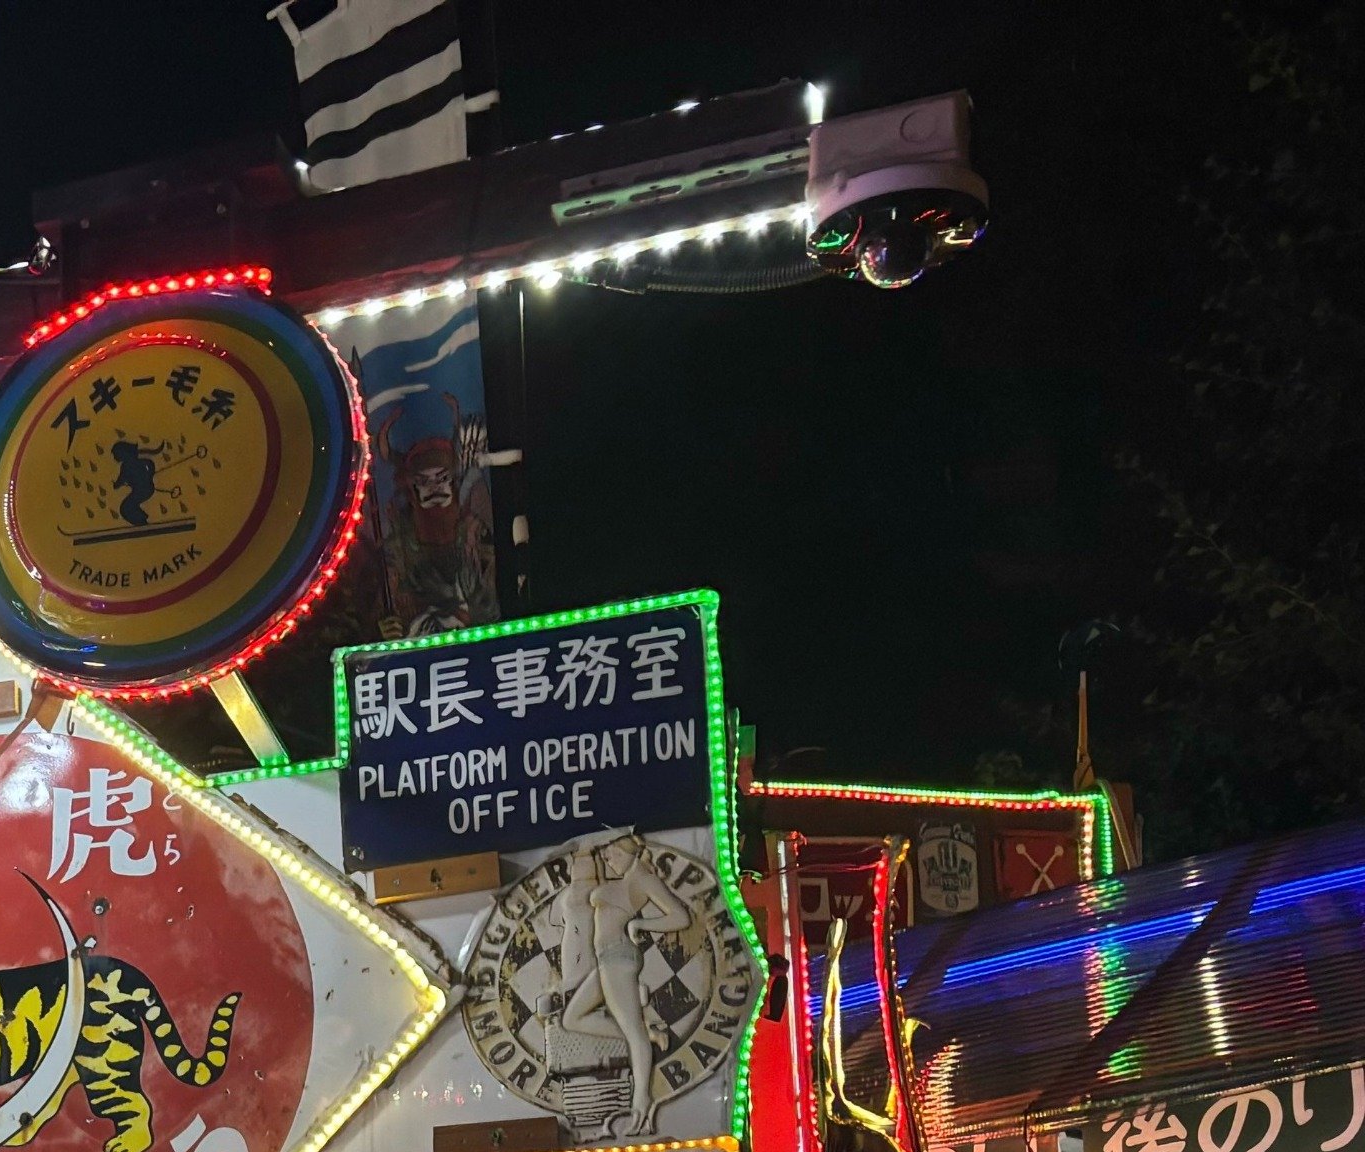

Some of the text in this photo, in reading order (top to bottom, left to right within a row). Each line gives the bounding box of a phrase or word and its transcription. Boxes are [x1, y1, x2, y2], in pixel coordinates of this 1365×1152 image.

[50, 364, 235, 451] スキー毛糸
[70, 545, 202, 588] TRADE MARK
[354, 626, 686, 740] 駅長事務室
[358, 718, 697, 802] PLATFORM OPERATION
[48, 767, 158, 882] 虎
[449, 779, 595, 835] OFFICE
[660, 984, 750, 1092] BANG
